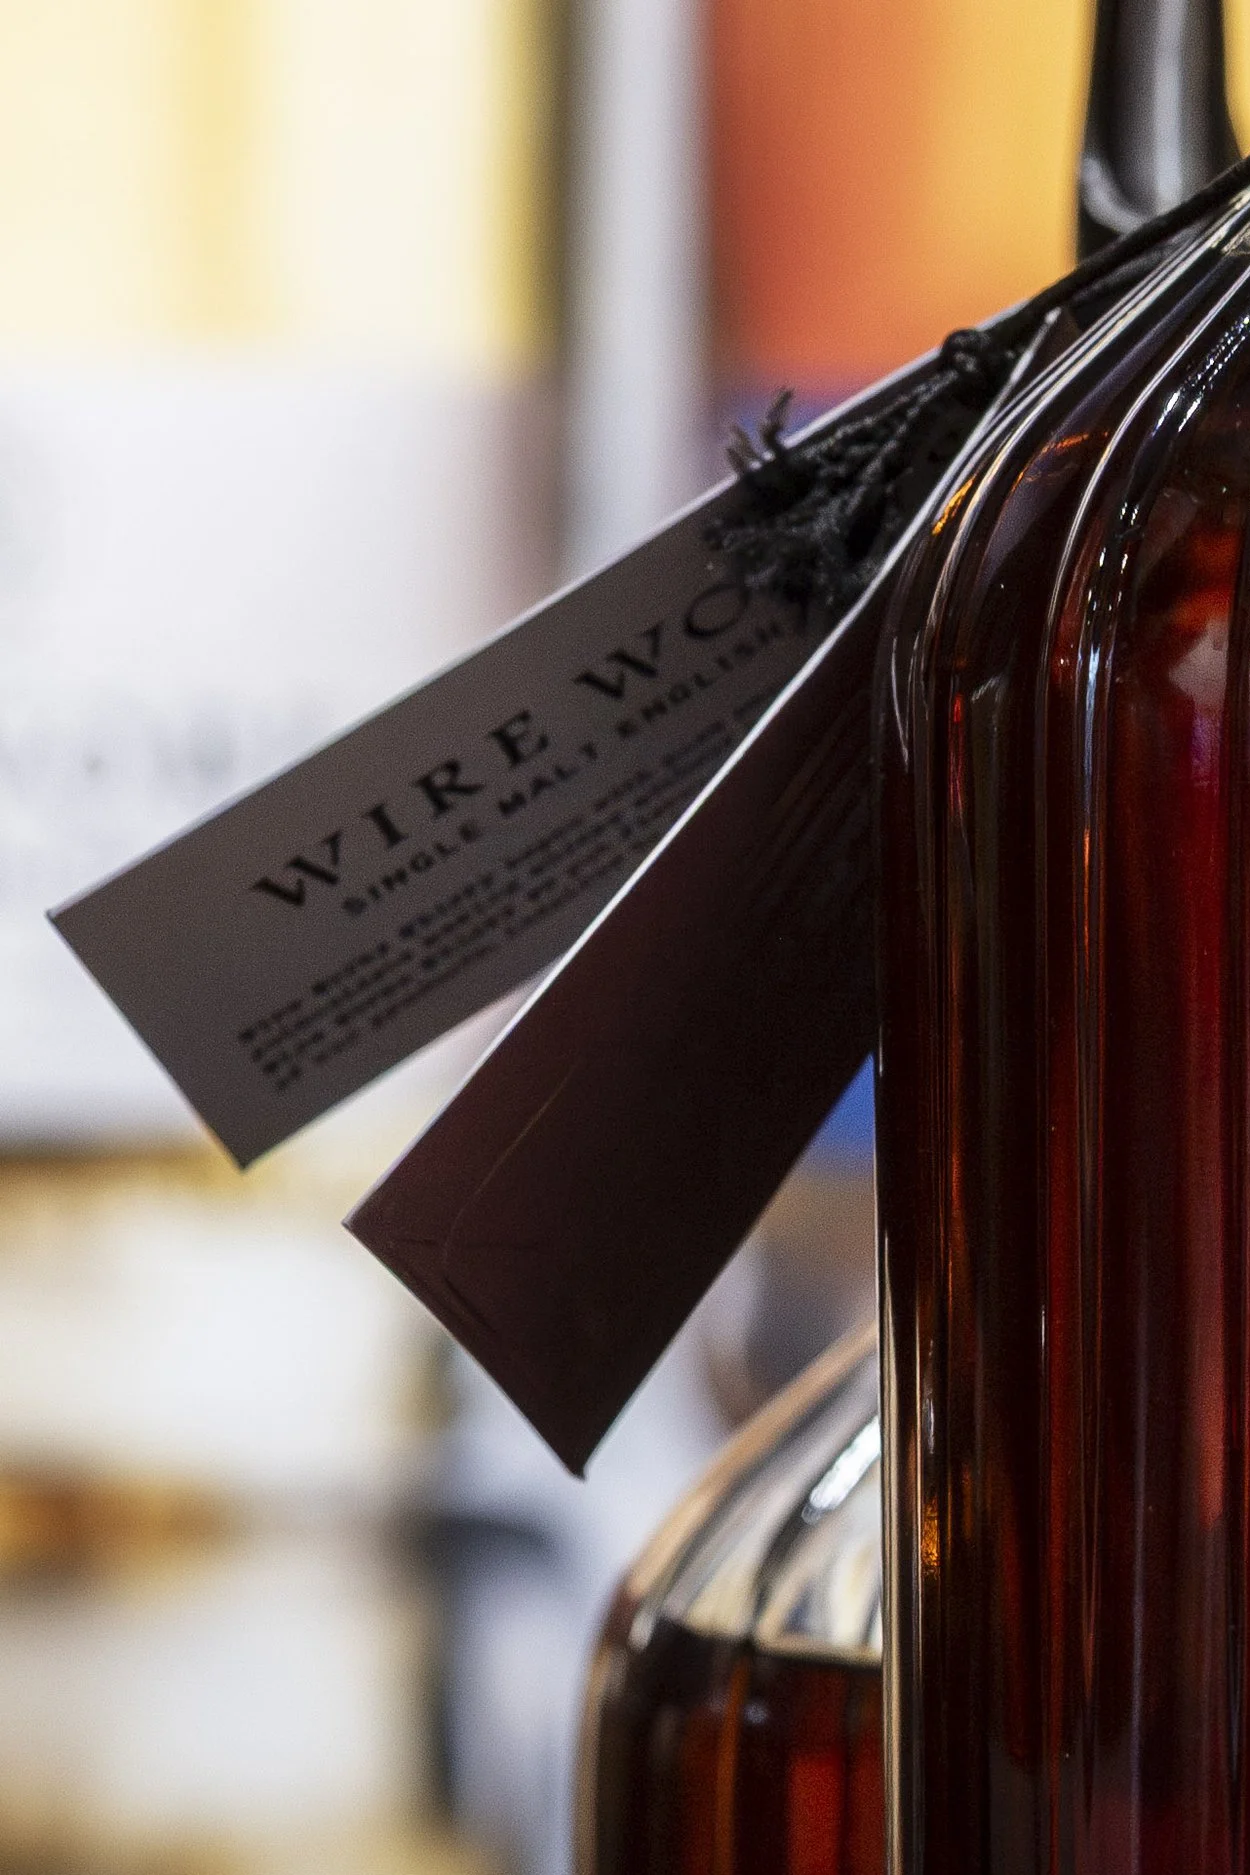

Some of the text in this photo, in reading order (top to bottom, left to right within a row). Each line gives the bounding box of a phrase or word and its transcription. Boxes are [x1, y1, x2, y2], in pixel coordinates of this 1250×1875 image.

[252, 708, 550, 909] WIRE
[341, 820, 482, 917] SINGLE
[498, 740, 600, 815] MALT
